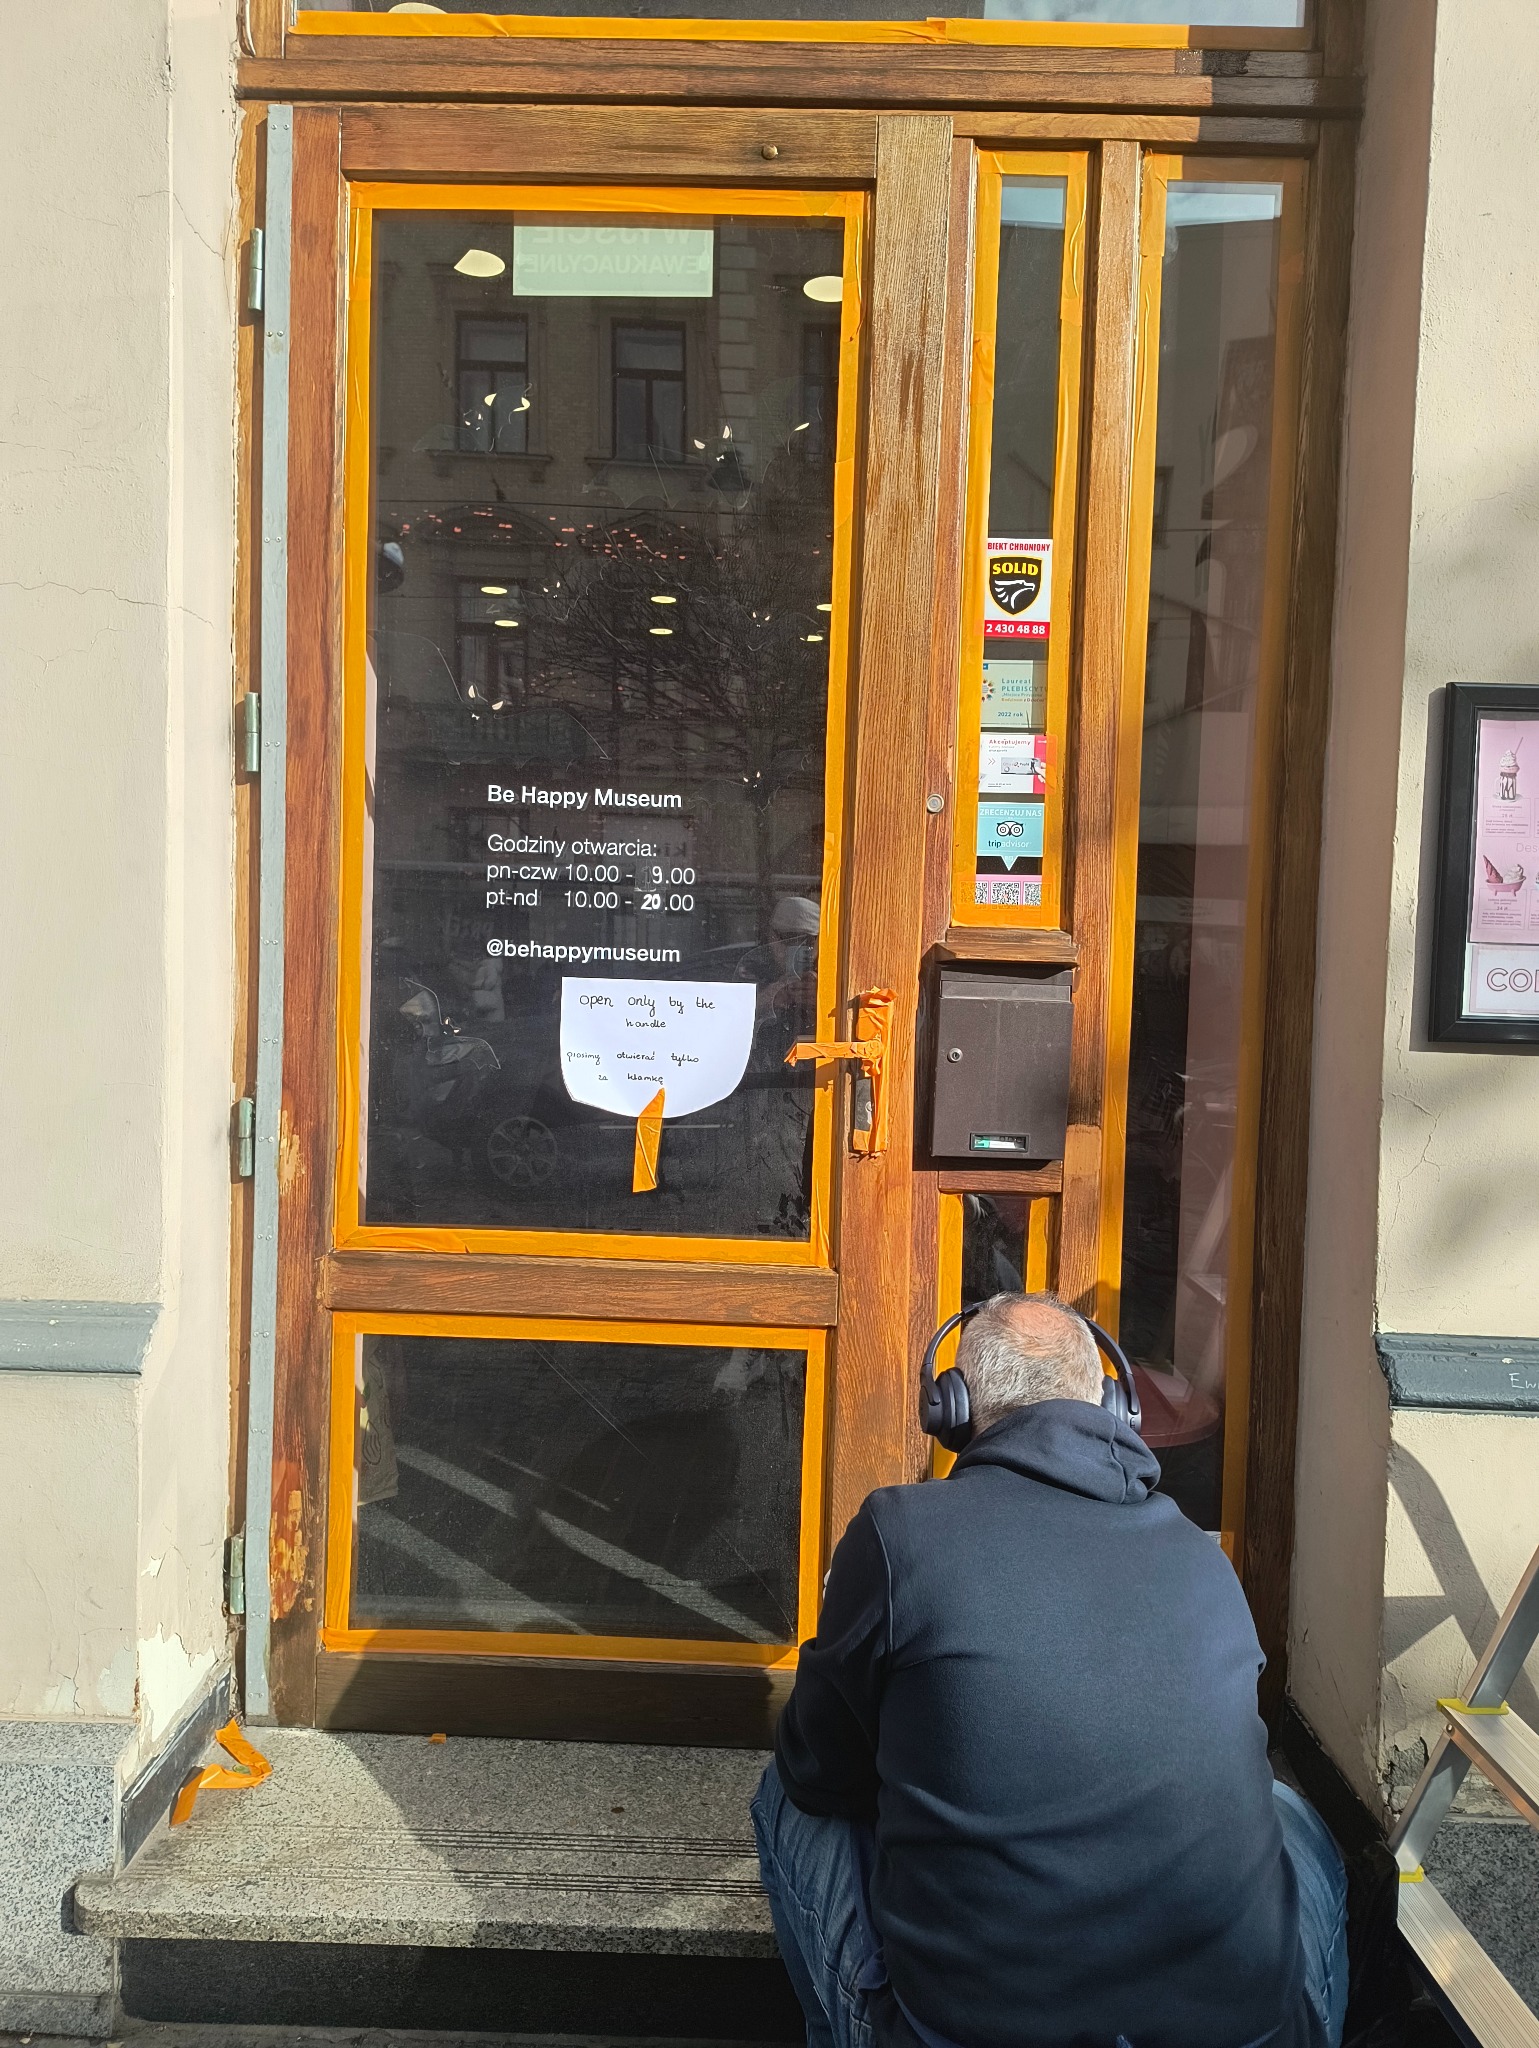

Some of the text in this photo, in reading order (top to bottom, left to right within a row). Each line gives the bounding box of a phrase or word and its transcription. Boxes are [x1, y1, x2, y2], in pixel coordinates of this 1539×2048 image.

[987, 542, 1051, 552] BIEKT CHRONIONY
[992, 562, 1039, 576] SOLID
[985, 623, 1046, 635] 2 430 48 88
[487, 784, 682, 810] Be Happy Museum
[979, 808, 1042, 817] ZRECENZUJ NAS
[486, 833, 566, 858] Godziny
[571, 838, 658, 857] otwarcia:
[988, 840, 1029, 848] tripadvisor
[1515, 842, 1539, 853] Des
[486, 863, 558, 883] pn-czw
[565, 863, 620, 883] 10.00
[486, 888, 538, 909] pt-nd
[564, 890, 619, 909] 10.00
[486, 938, 681, 964] @behappymuseum
[1486, 967, 1539, 993] CO
[627, 994, 656, 1018] only
[668, 995, 685, 1015] by
[695, 996, 716, 1010] the
[625, 1018, 667, 1028] handle
[616, 1050, 656, 1062] otwierać
[1508, 1372, 1539, 1389] Ew
